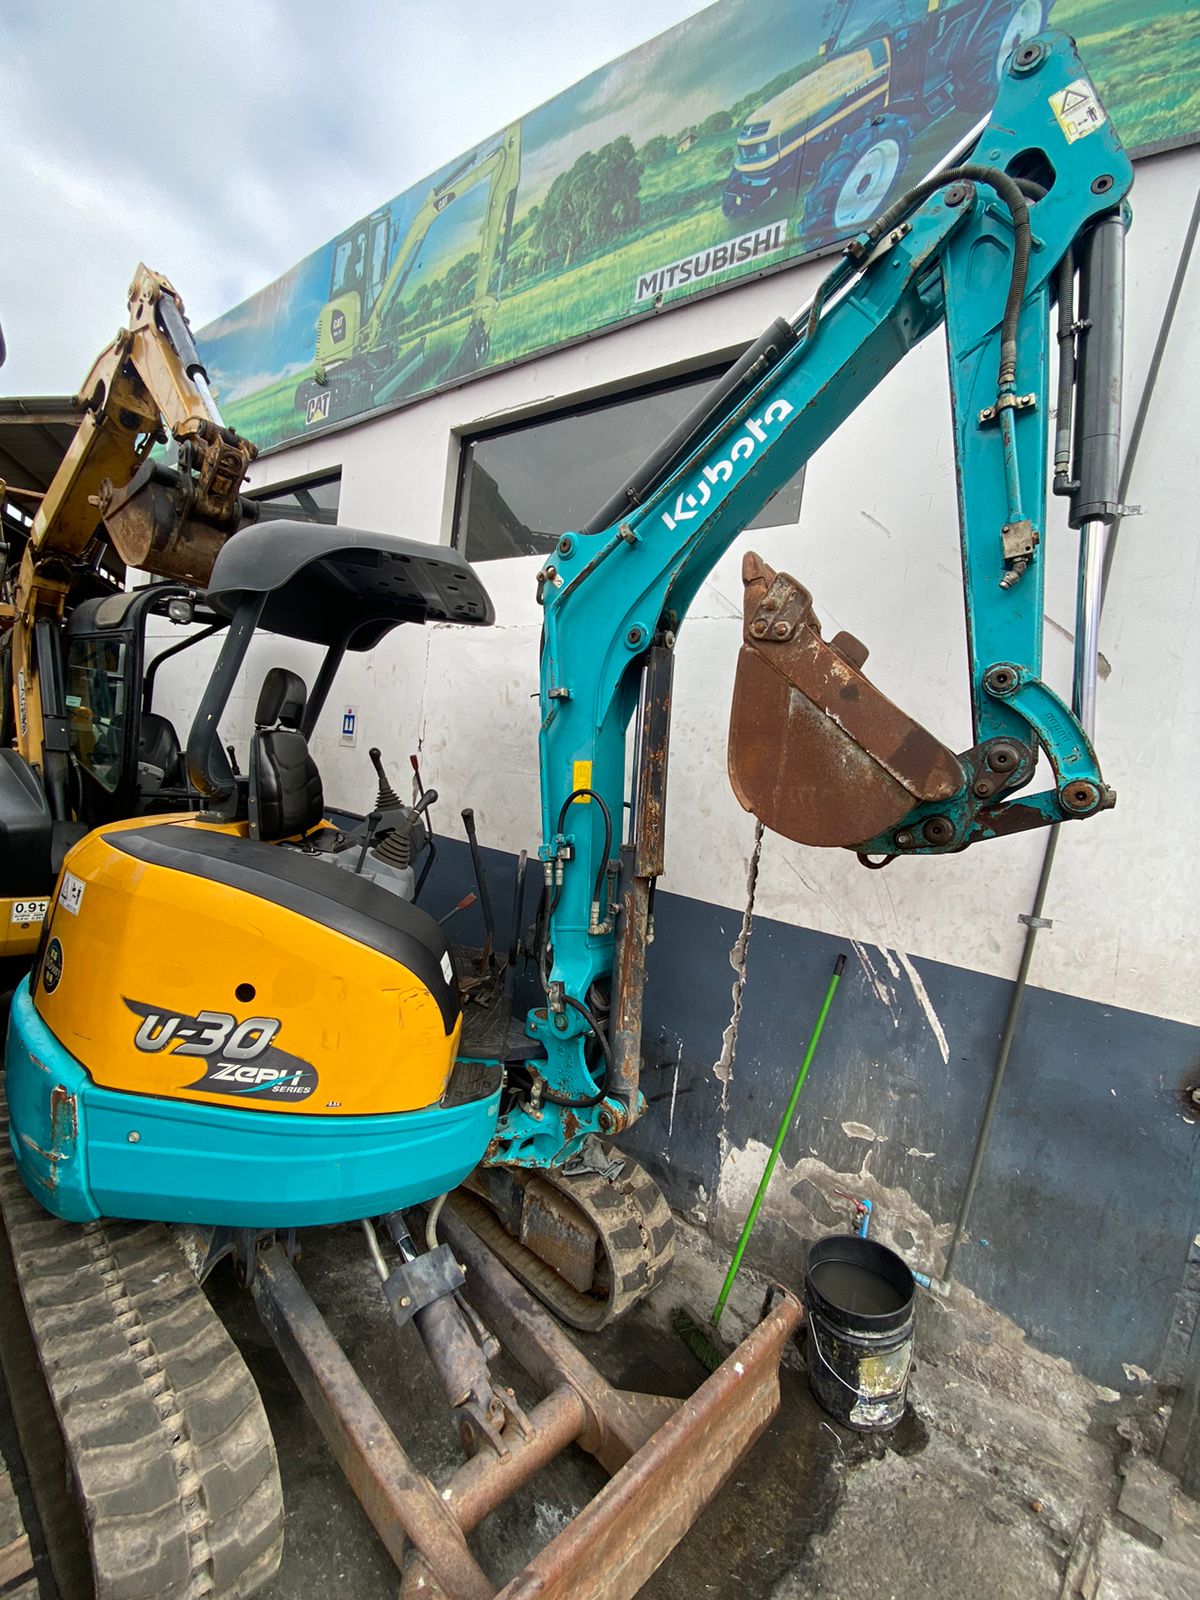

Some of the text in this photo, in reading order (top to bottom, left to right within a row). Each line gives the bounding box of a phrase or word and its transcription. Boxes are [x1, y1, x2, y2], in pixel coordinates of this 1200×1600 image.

[638, 225, 781, 299] MITSUBISHI
[333, 316, 343, 330] CAT
[306, 395, 329, 423] CAT
[661, 399, 794, 531] Kubota
[135, 1011, 281, 1060] U-30
[272, 1085, 311, 1094] SERIES
